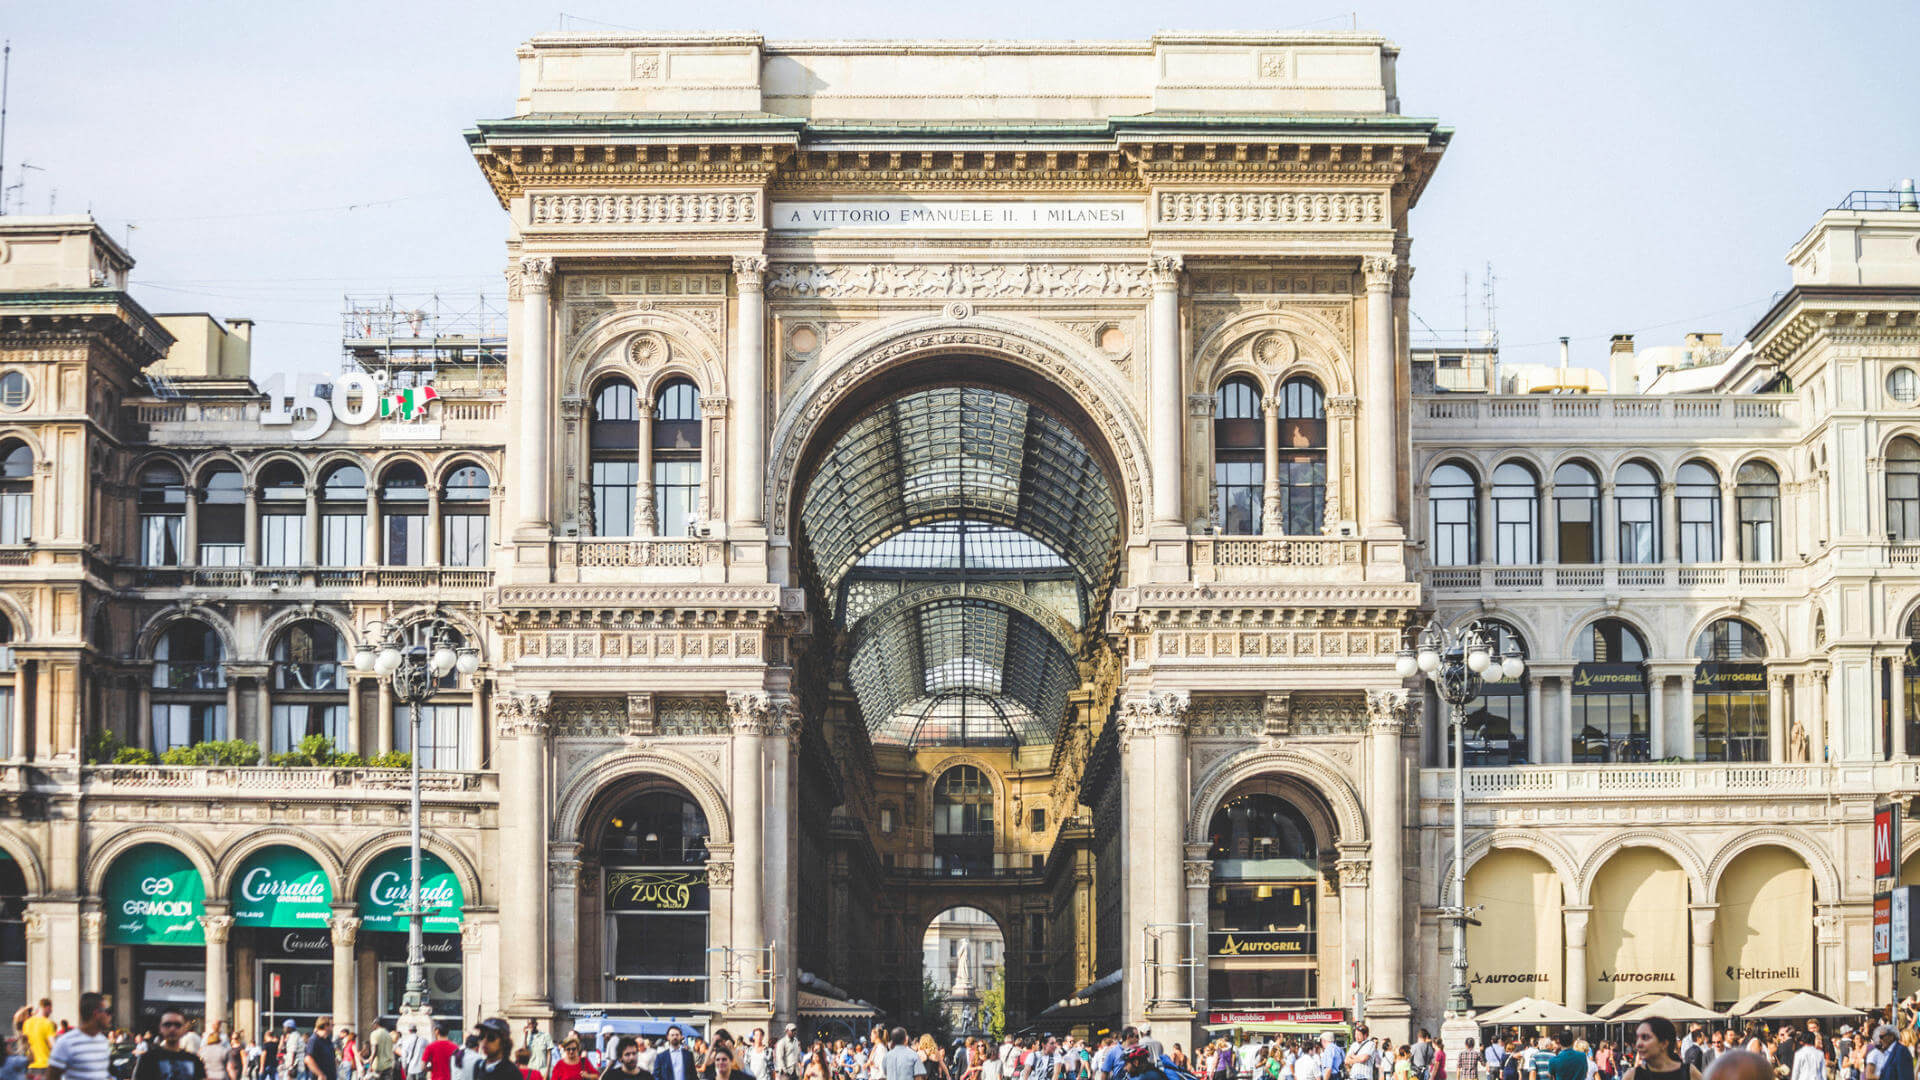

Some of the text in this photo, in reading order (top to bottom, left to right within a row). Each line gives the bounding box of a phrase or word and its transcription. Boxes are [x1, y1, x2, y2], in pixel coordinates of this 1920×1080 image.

[791, 211, 801, 222] A
[813, 210, 890, 222] VITTORIO
[901, 209, 993, 222] EMANUELE
[1048, 209, 1124, 222] MILANESI
[1593, 674, 1642, 682] AUTOGRILL
[1713, 673, 1762, 681] AUTOGRILL
[1875, 823, 1890, 863] M
[241, 867, 324, 902] Currado
[370, 871, 454, 905] Curado
[282, 932, 329, 953] Currado
[1241, 942, 1301, 951] AUTOGRILL
[1485, 973, 1550, 983] AUTOGRILL
[1612, 973, 1676, 982] AUTOGRILL
[1737, 967, 1800, 979] Feltrinelli
[1229, 1012, 1266, 1023] Repubblica
[1296, 1012, 1333, 1021] Repubblica
